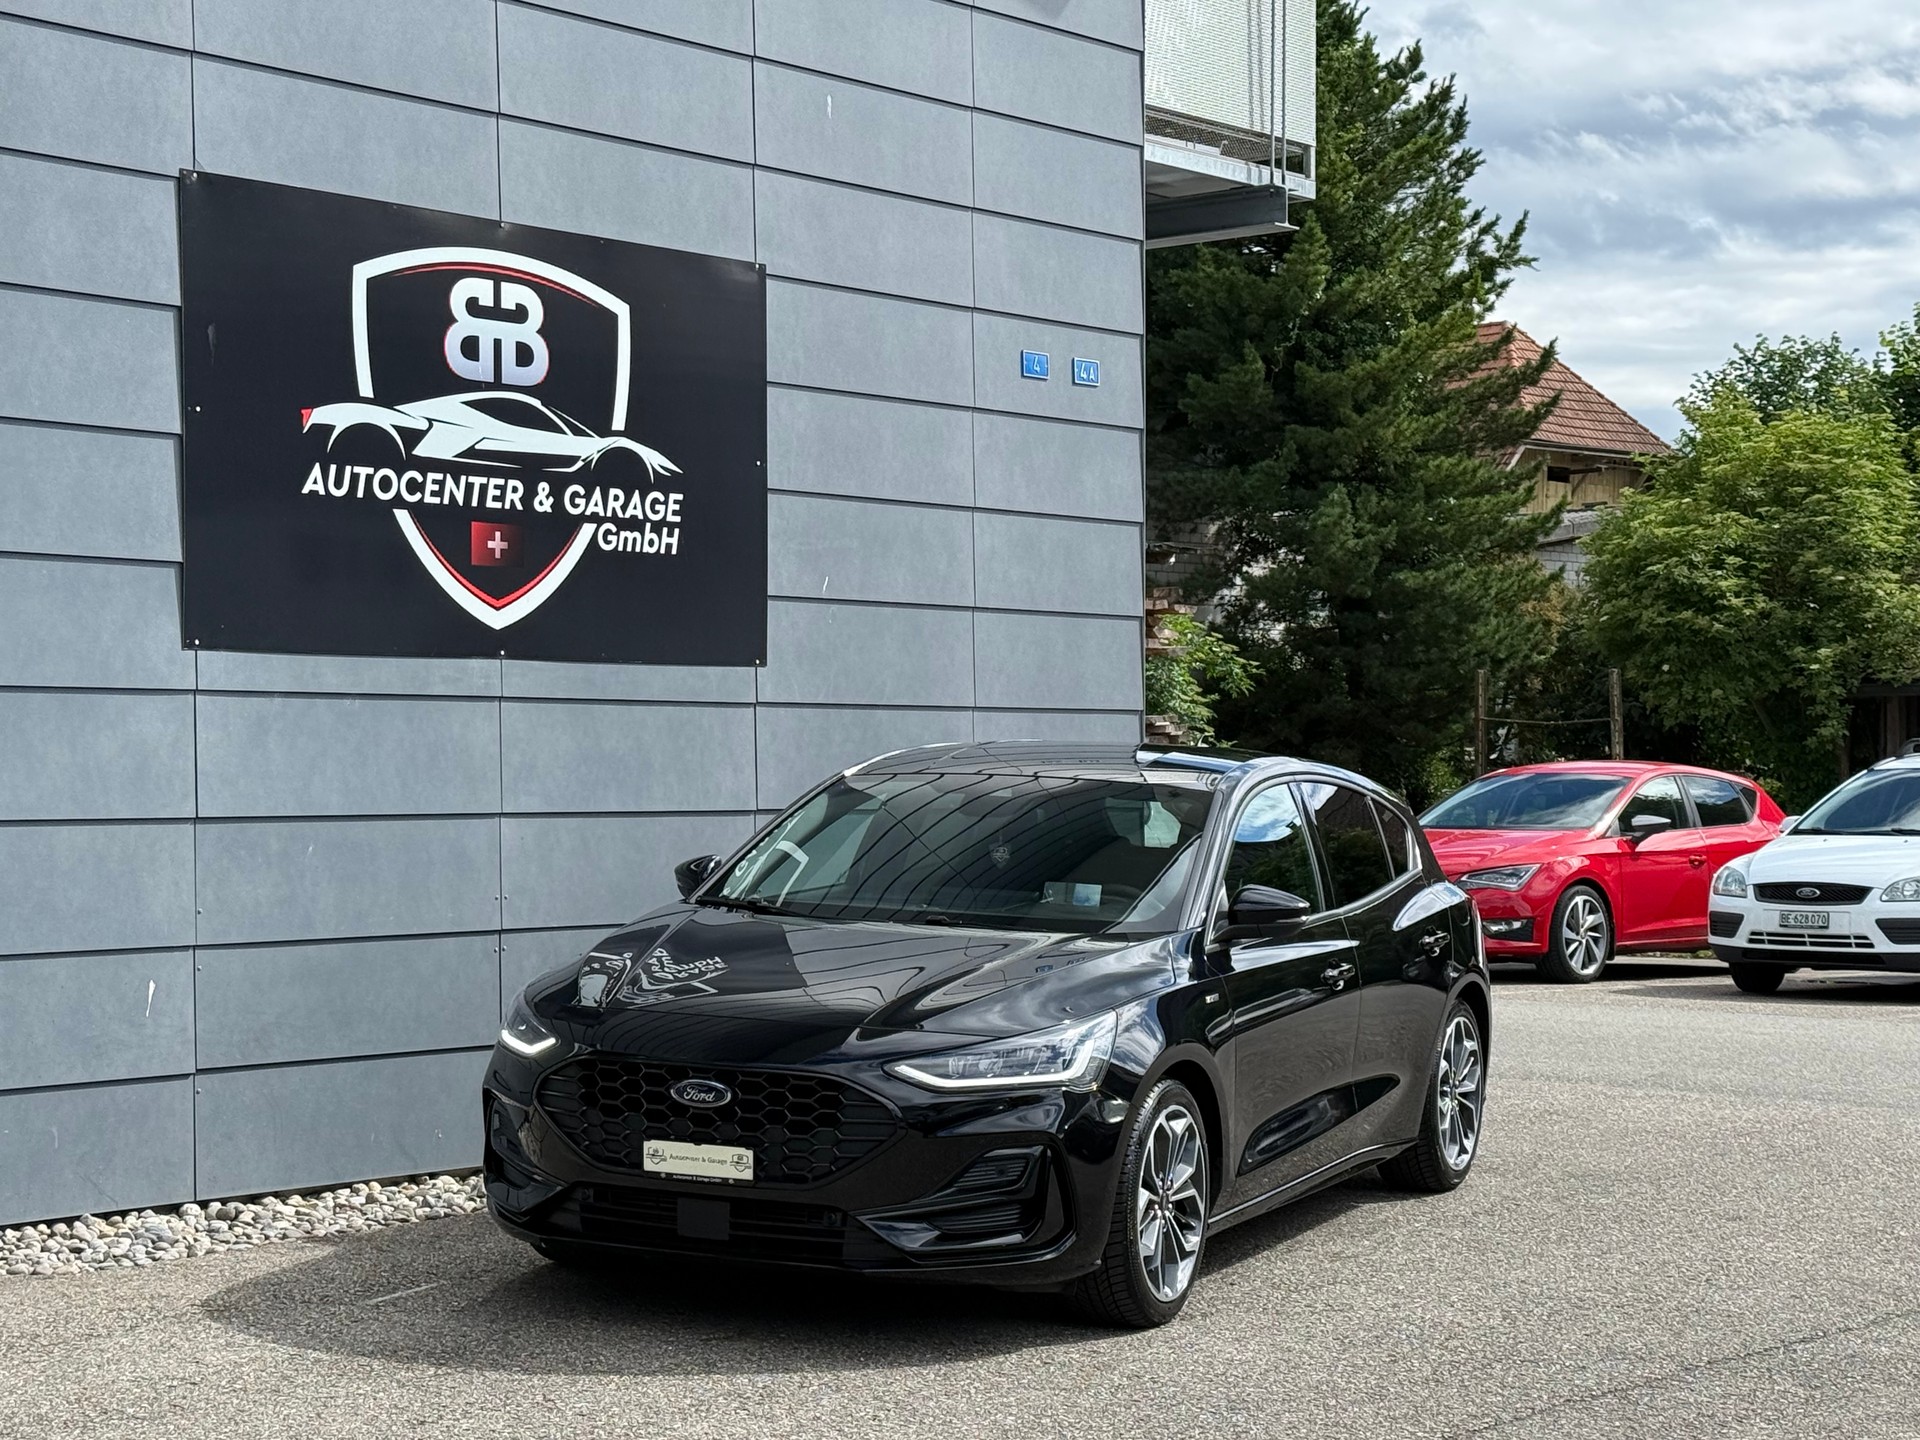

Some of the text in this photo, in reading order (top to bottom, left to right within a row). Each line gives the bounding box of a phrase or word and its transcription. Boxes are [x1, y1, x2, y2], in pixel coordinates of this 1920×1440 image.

[1080, 363, 1095, 380] 4A
[301, 461, 684, 523] AUTOCENTER & GARAGE
[597, 522, 680, 555] GmbH
[683, 1085, 716, 1102] Ford
